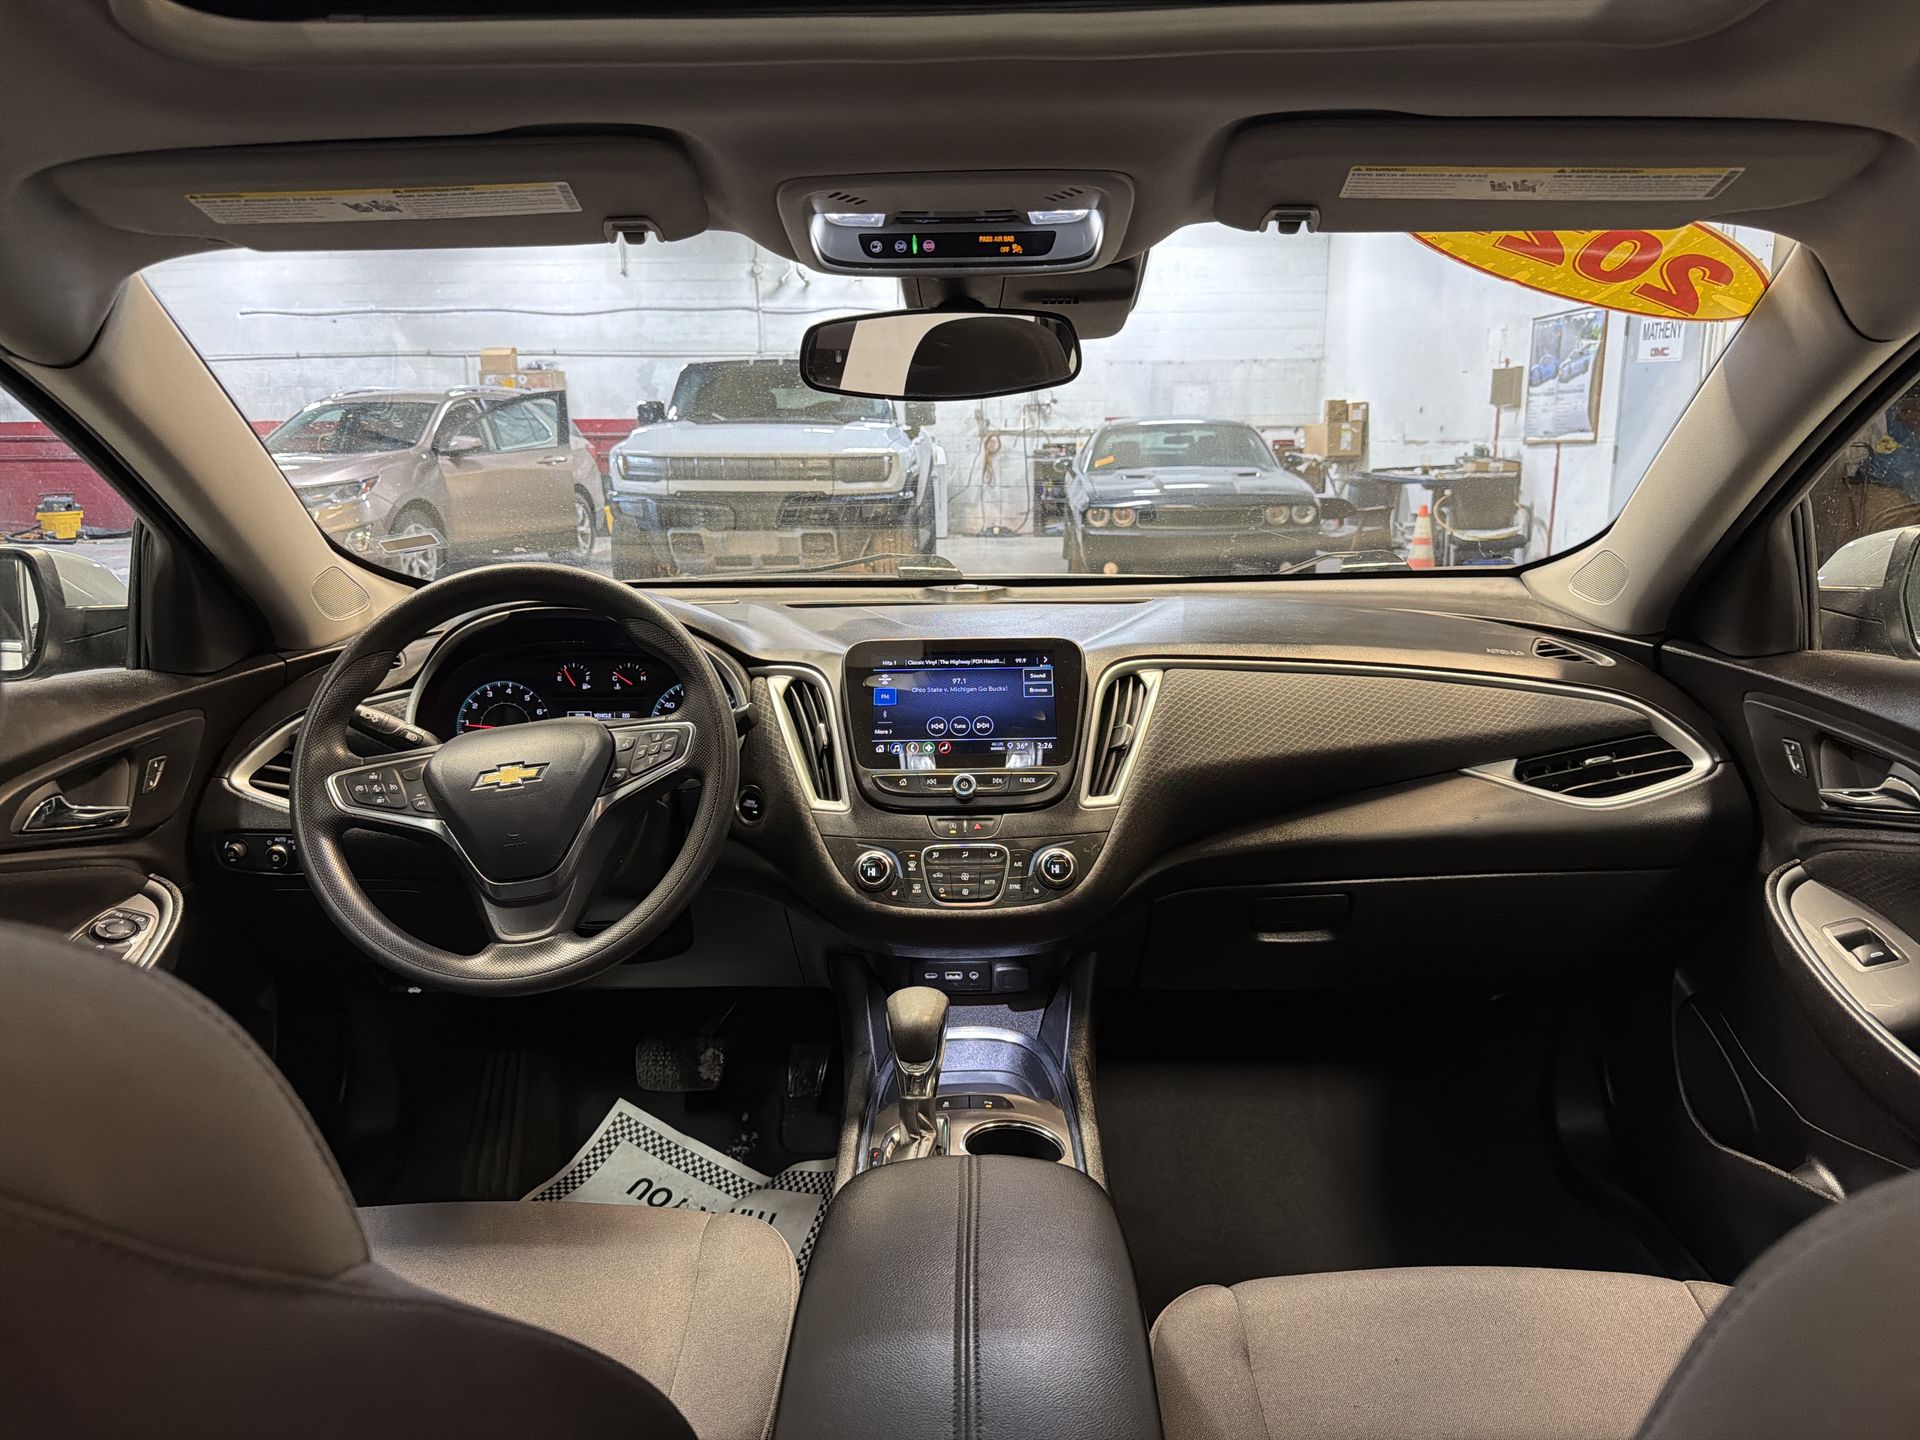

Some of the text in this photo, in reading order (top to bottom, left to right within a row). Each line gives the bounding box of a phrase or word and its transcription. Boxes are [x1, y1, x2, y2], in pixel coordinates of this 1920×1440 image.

[1642, 321, 1682, 340] MATHENY
[1650, 347, 1669, 357] GMC
[867, 867, 876, 877] HI
[1051, 864, 1060, 874] HI
